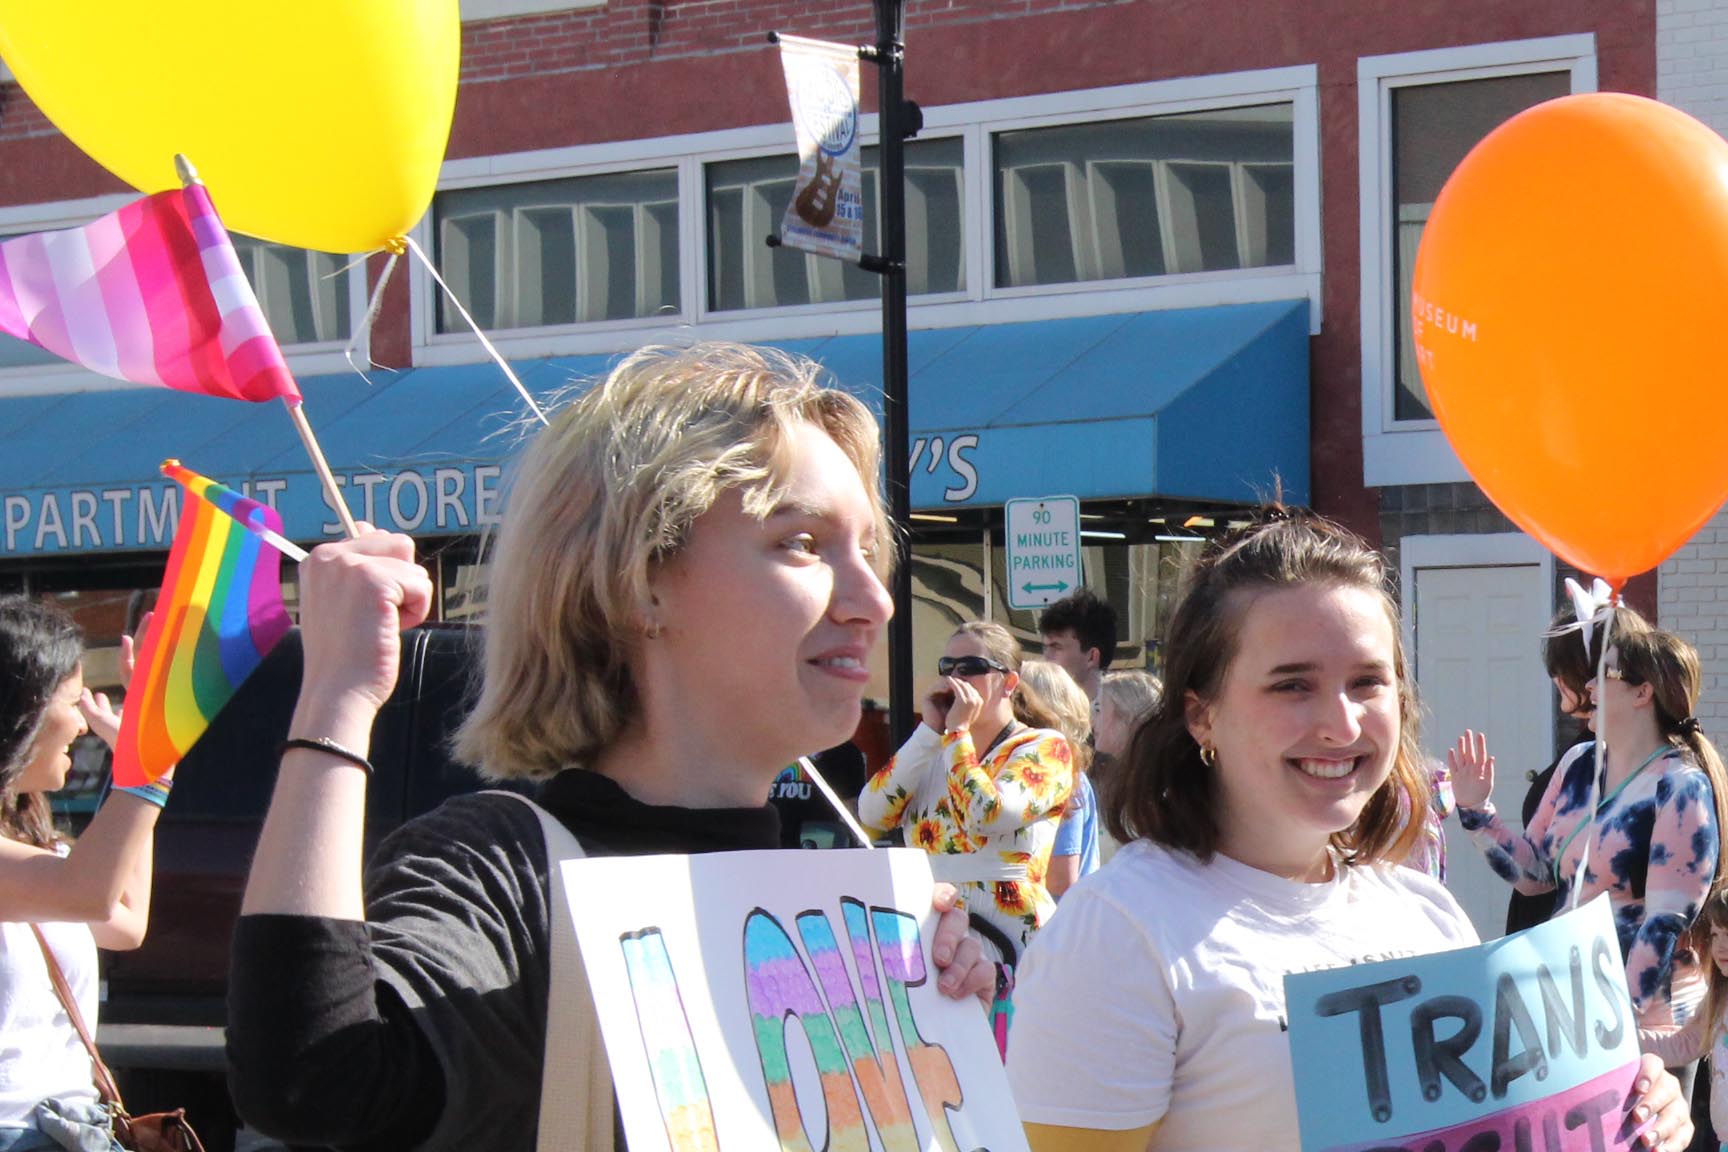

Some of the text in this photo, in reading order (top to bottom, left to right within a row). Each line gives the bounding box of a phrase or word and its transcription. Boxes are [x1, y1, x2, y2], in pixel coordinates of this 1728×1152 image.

[1412, 291, 1477, 342] USEUM
[3, 464, 502, 551] PARTMT STORE
[1033, 510, 1051, 525] 90
[1017, 532, 1069, 547] MINUTE
[1013, 554, 1075, 570] PARKING
[1314, 935, 1625, 1124] TRANS
